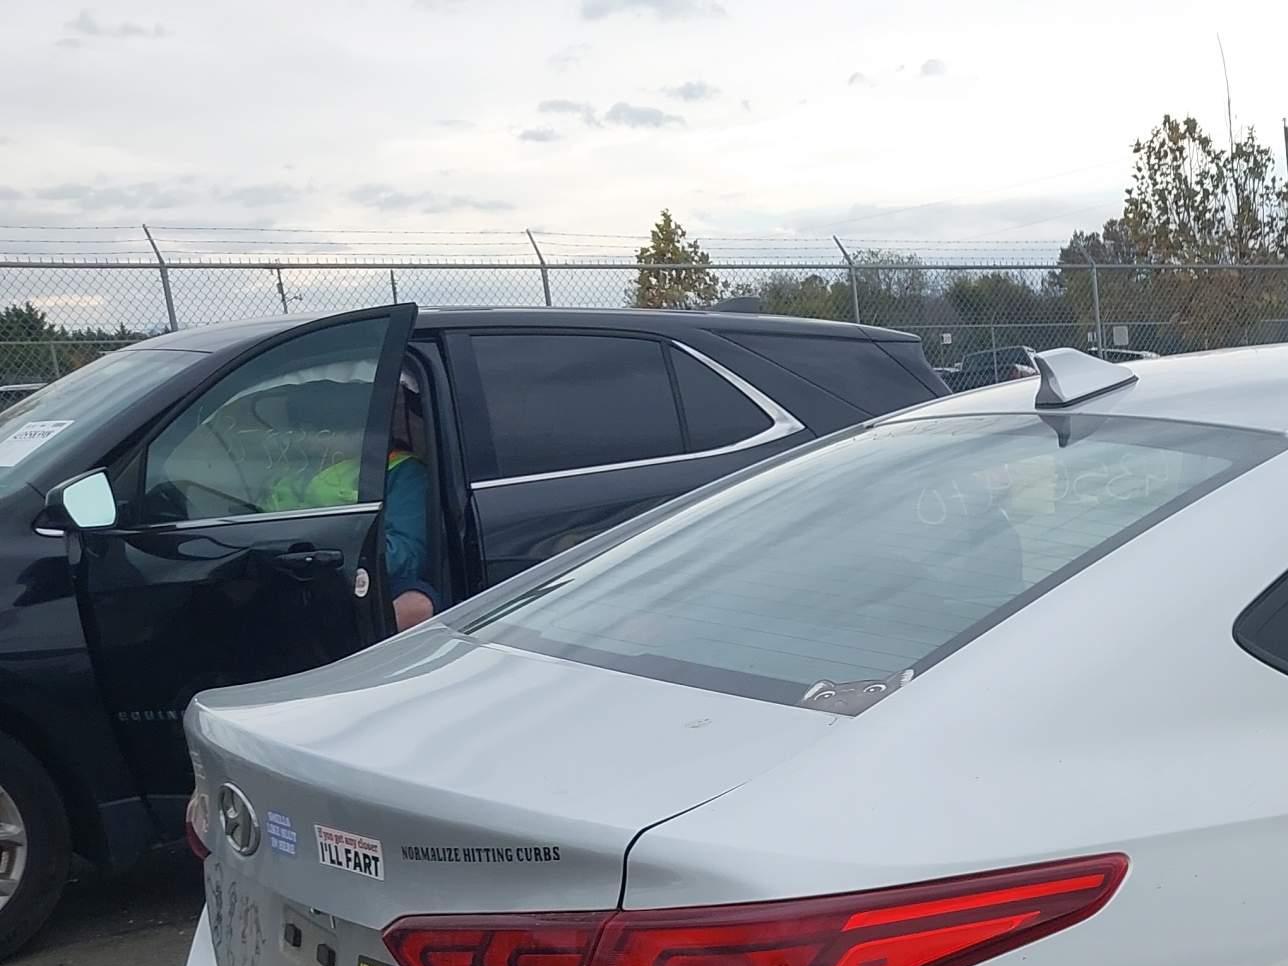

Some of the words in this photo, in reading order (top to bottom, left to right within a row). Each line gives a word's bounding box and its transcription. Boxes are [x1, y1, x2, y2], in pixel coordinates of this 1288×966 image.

[117, 710, 184, 722] EQUIN
[320, 841, 343, 867] I'LL
[344, 847, 379, 877] FART
[401, 846, 461, 862] NORMALIZE
[463, 847, 513, 863] HITTING
[516, 846, 561, 862] CURBS
